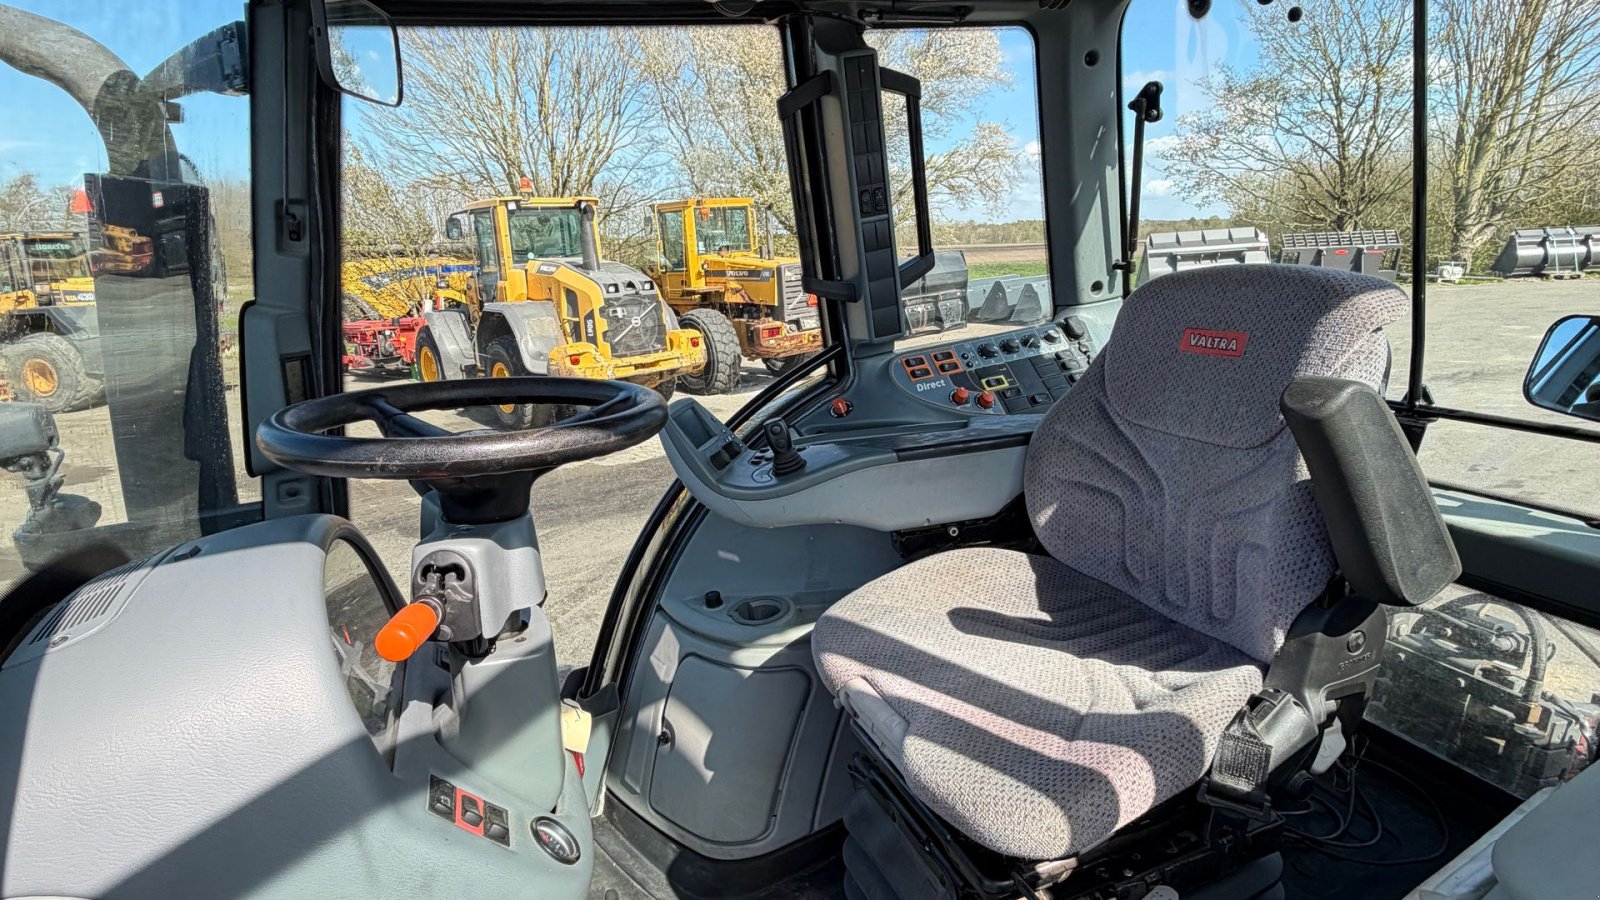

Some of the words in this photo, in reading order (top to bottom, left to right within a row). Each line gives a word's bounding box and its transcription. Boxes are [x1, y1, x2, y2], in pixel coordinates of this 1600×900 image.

[586, 319, 594, 337] L90G
[1190, 333, 1237, 351] VALTRA
[916, 378, 946, 392] Direct
